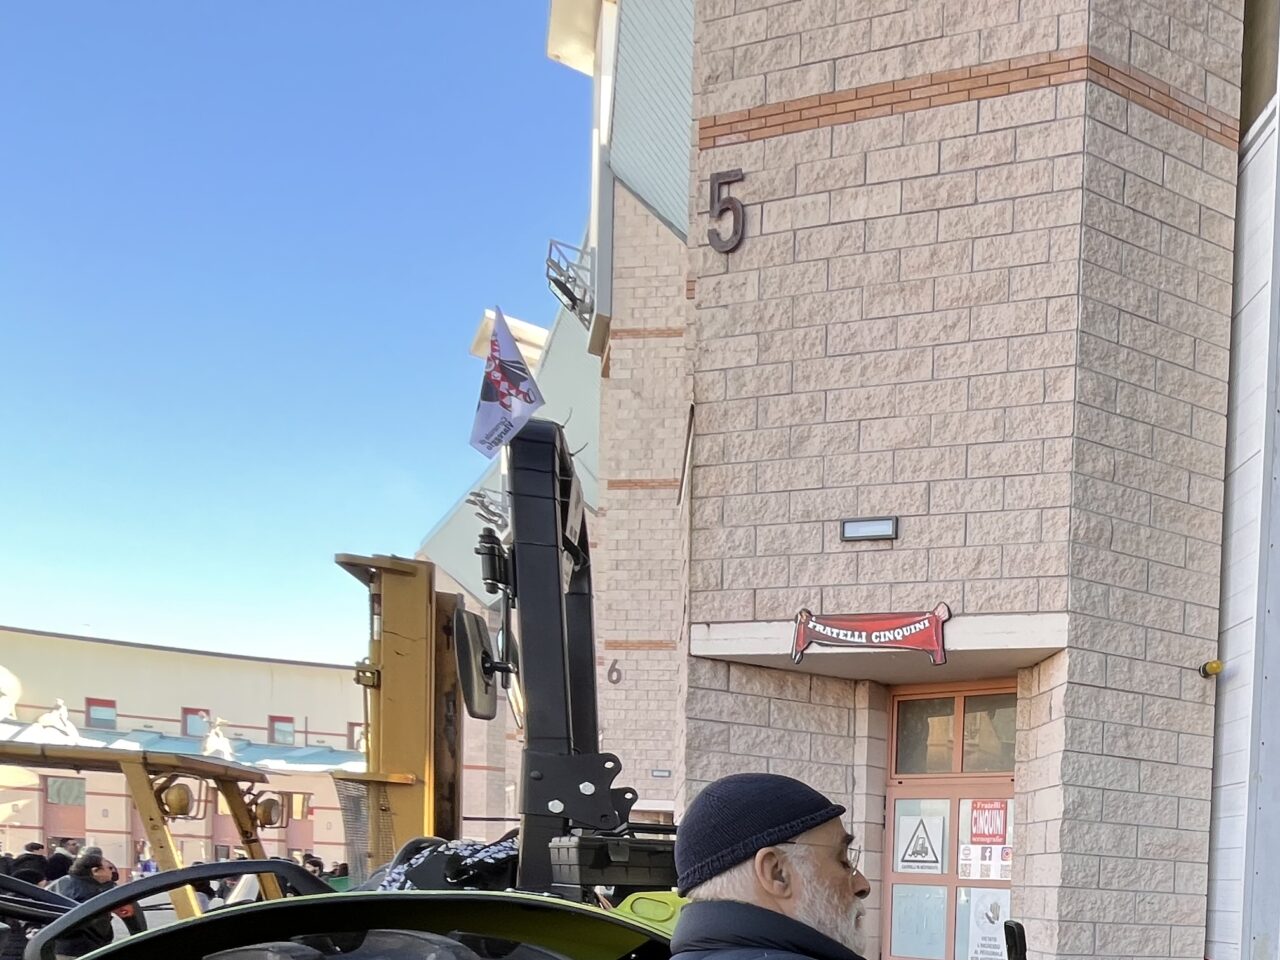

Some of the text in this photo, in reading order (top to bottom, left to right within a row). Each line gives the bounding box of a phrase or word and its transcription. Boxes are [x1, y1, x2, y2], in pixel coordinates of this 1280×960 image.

[708, 168, 744, 254] 5
[807, 618, 930, 643] FRATELLI CINQUINI
[607, 658, 622, 685] 6
